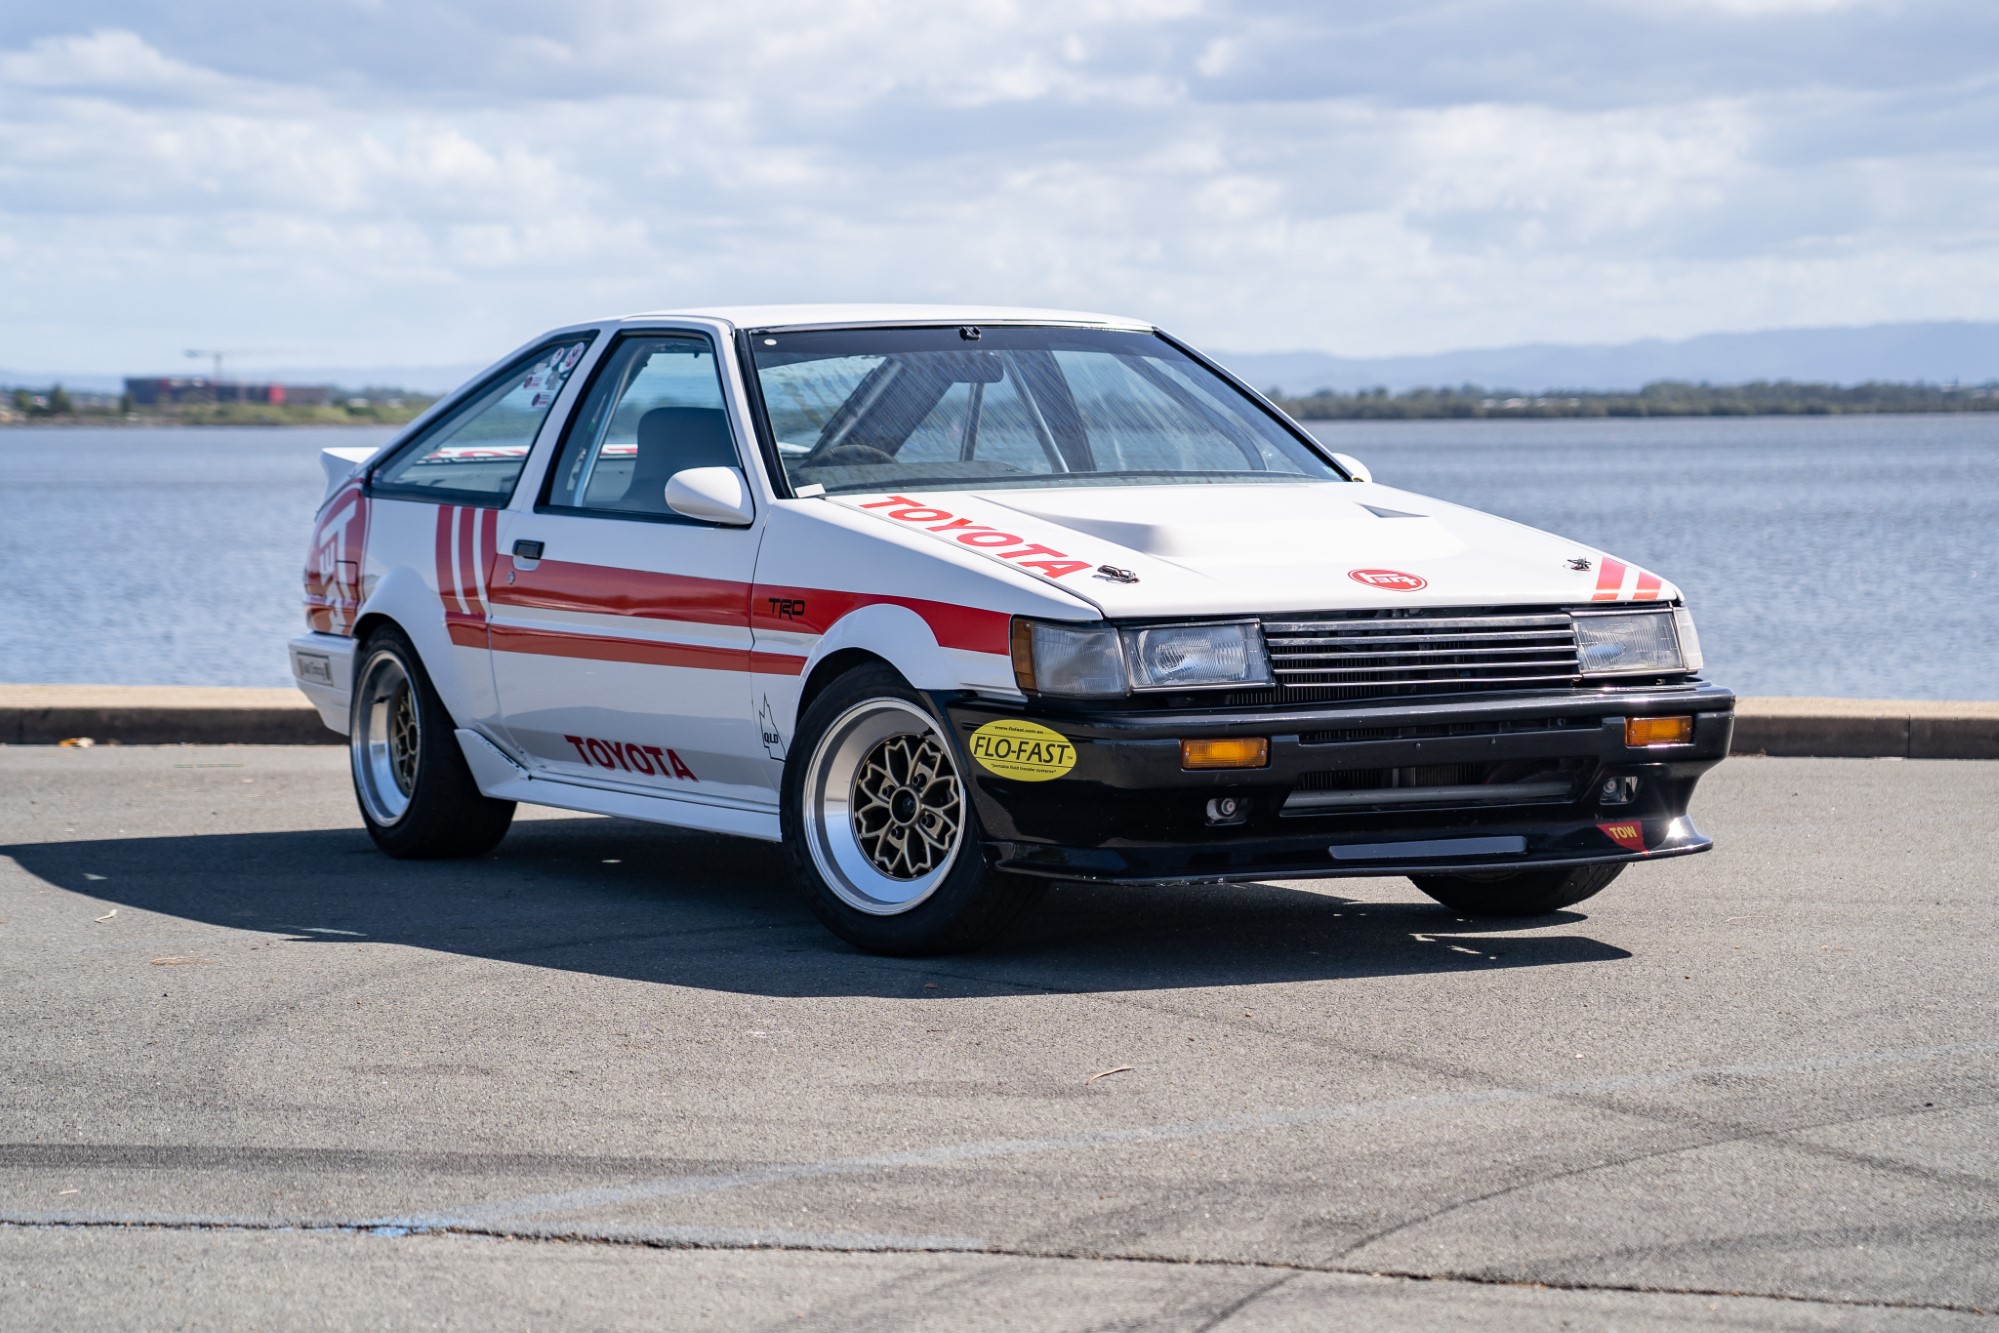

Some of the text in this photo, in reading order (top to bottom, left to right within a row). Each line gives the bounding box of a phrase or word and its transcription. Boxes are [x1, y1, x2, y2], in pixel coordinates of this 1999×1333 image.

[858, 495, 1093, 579] TOYOTA
[769, 597, 805, 620] TRD
[764, 732, 779, 744] QLD
[973, 736, 1070, 765] FLO-FAST
[563, 734, 700, 783] TOYOTA
[1608, 825, 1638, 840] TOW
